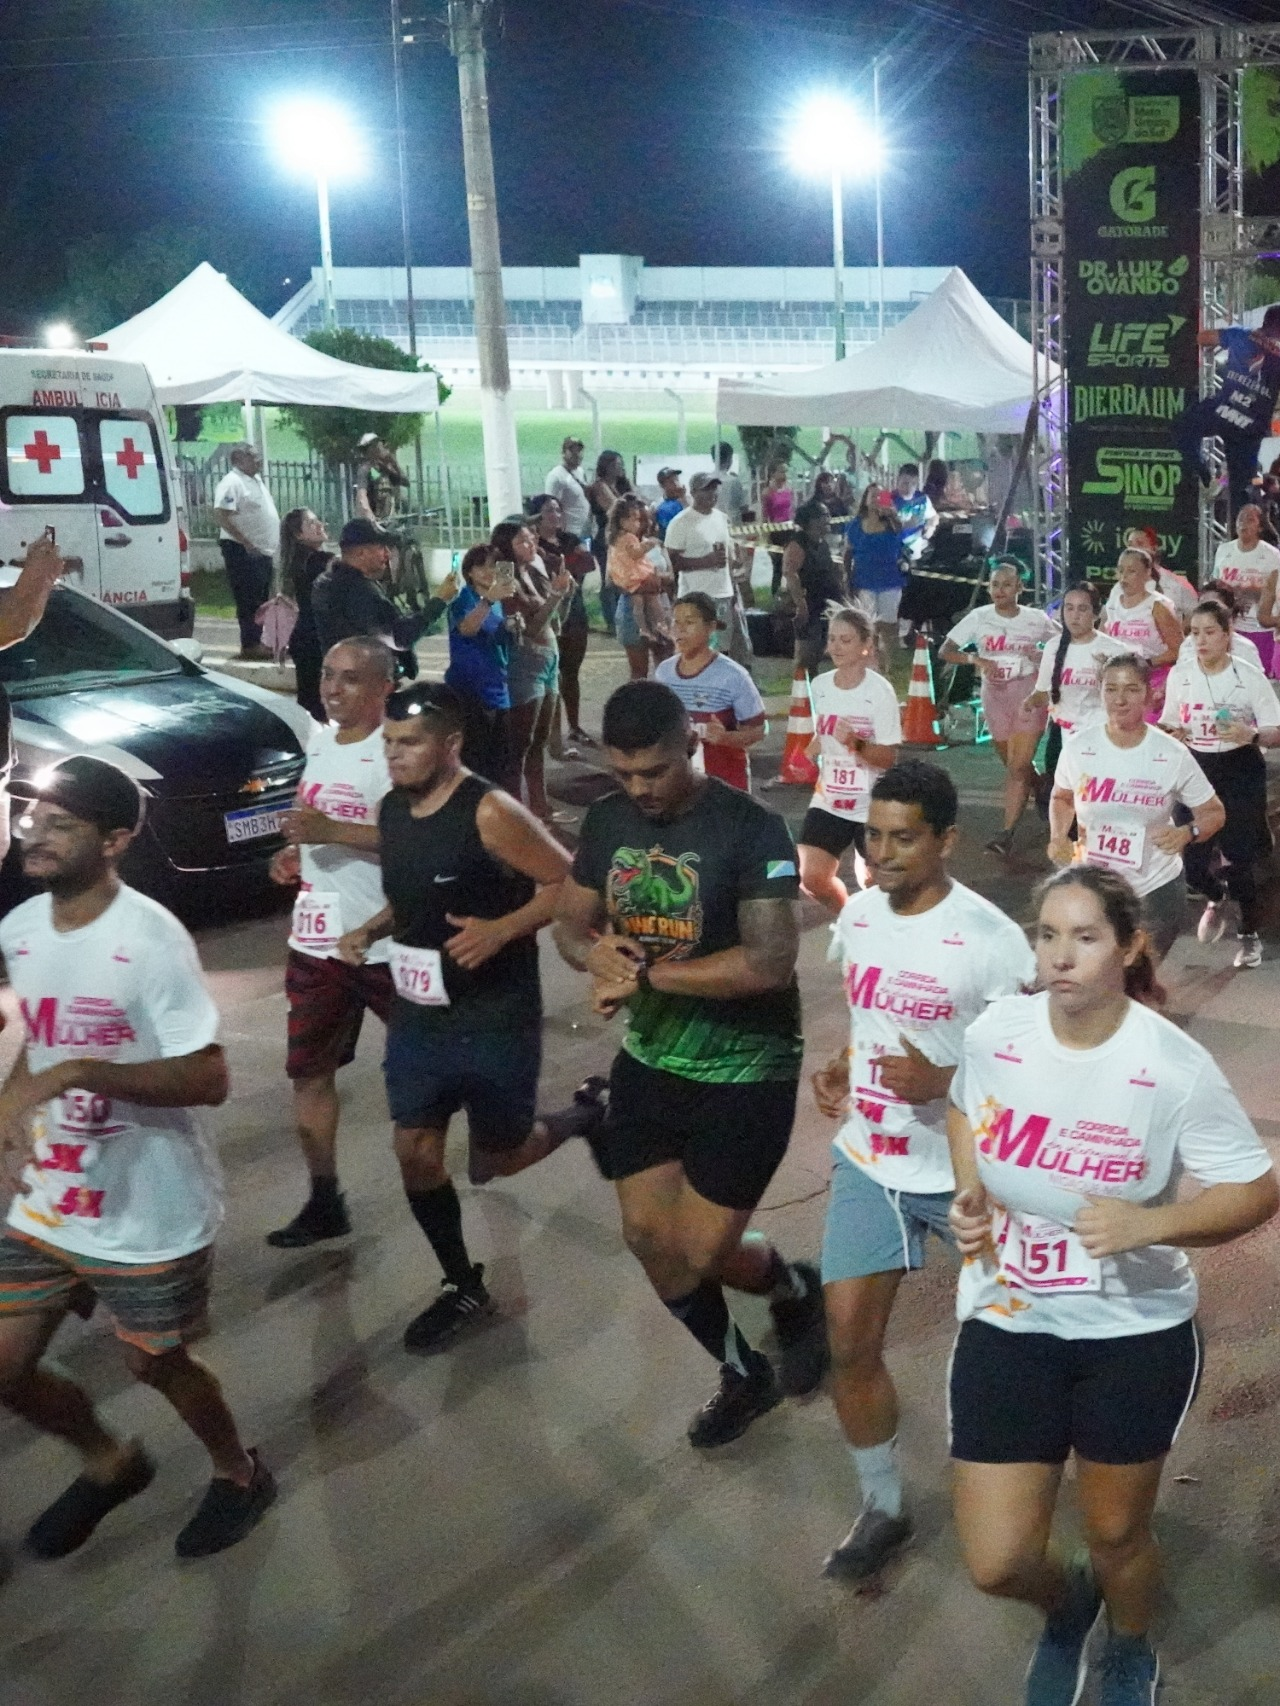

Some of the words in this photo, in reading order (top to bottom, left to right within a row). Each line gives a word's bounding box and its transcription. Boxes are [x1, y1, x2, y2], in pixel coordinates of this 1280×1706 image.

[1098, 226, 1169, 238] GATORADE
[1117, 260, 1165, 278] LUIZ
[1086, 277, 1179, 296] OVANDO
[1086, 353, 1171, 368] SPORTS
[1074, 382, 1185, 423] BIERBAUM
[1082, 447, 1183, 497] SINOP
[1200, 723, 1218, 737] 14
[833, 768, 856, 786] 181
[1081, 776, 1165, 807] MULHER
[234, 815, 282, 839] SMB3H
[1097, 834, 1131, 856] 148
[844, 962, 954, 1021] MULHER
[1076, 1119, 1130, 1136] CORRIDA
[979, 1108, 1146, 1183] MULHER
[1069, 1129, 1143, 1147] CAMINHADA
